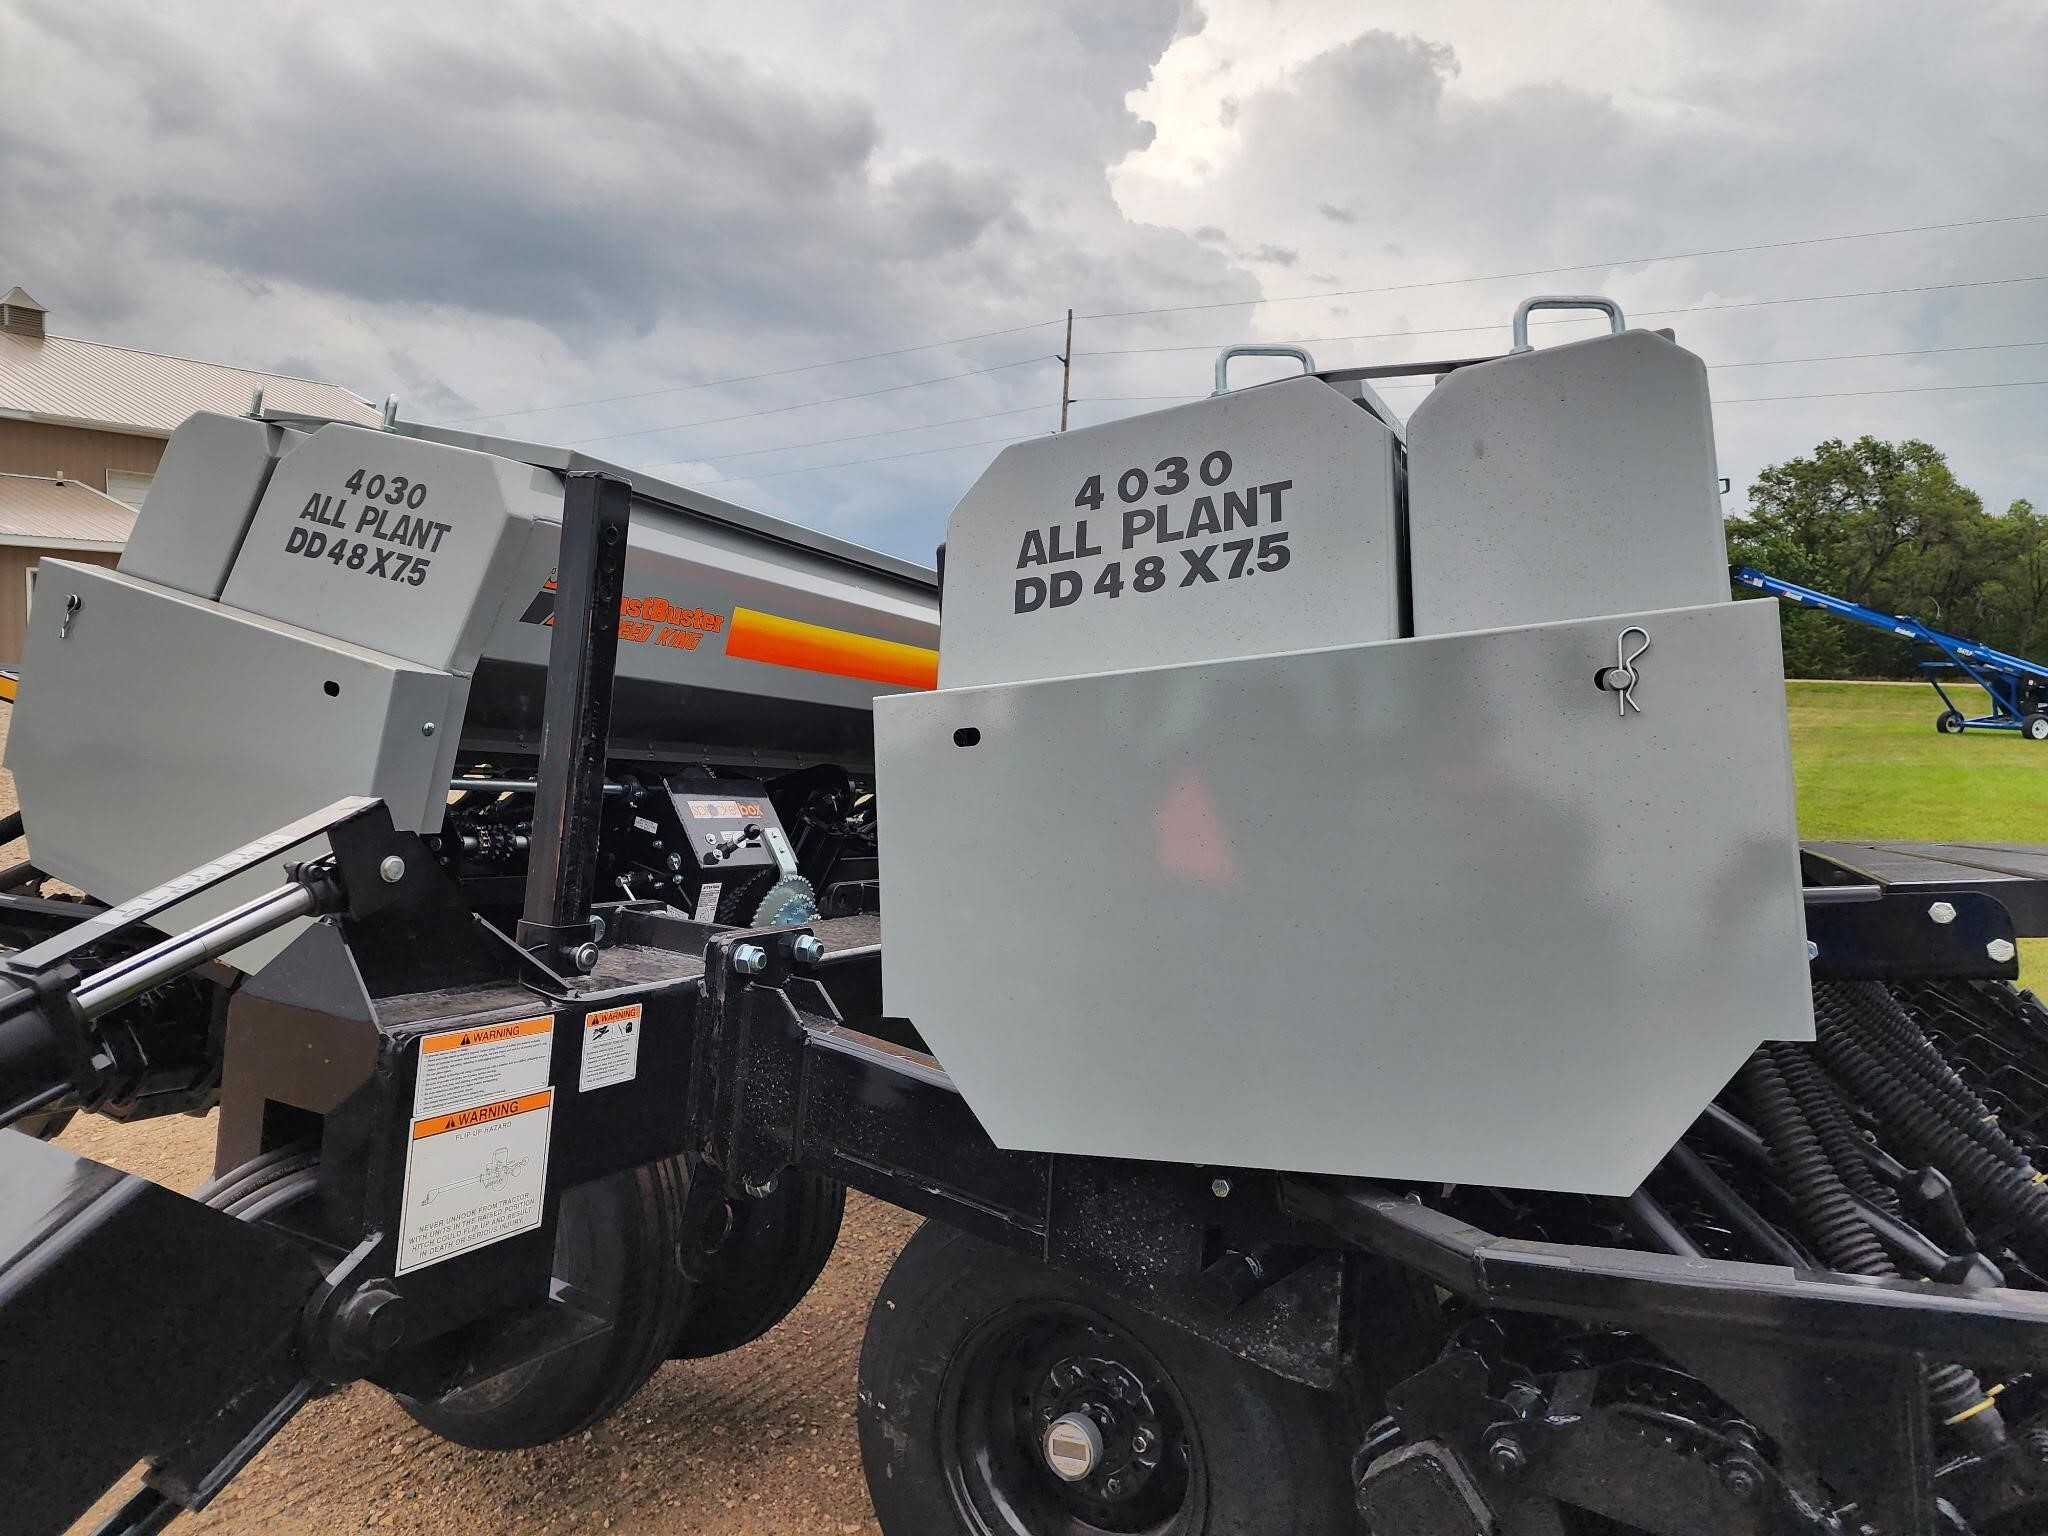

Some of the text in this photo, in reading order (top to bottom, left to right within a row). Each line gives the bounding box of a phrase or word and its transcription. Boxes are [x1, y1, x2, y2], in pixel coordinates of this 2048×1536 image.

[344, 468, 427, 510] 4030
[1074, 450, 1233, 511] 4030
[299, 492, 453, 553] ALL PLANT
[1016, 479, 1293, 570] ALL PLANT
[618, 619, 704, 651] EED KING
[601, 1008, 636, 1022] WARNING
[473, 1026, 520, 1043] WARNING
[455, 1121, 512, 1141] FLIP UP HAZARD
[459, 1101, 519, 1126] WARNING
[408, 1232, 428, 1244] WITH
[430, 1225, 452, 1238] UNITS
[453, 1222, 461, 1231] IN
[462, 1218, 476, 1228] THE
[477, 1209, 502, 1223] RAISED
[411, 1207, 532, 1252] HITCH COULD FLIP UP AND RESULT
[418, 1192, 529, 1233] NEVER UNHOOK FROM TRACTOR
[419, 1250, 427, 1258] IN
[429, 1240, 454, 1254] DEATH
[455, 1237, 466, 1246] OR
[467, 1226, 498, 1241] SERIOUS
